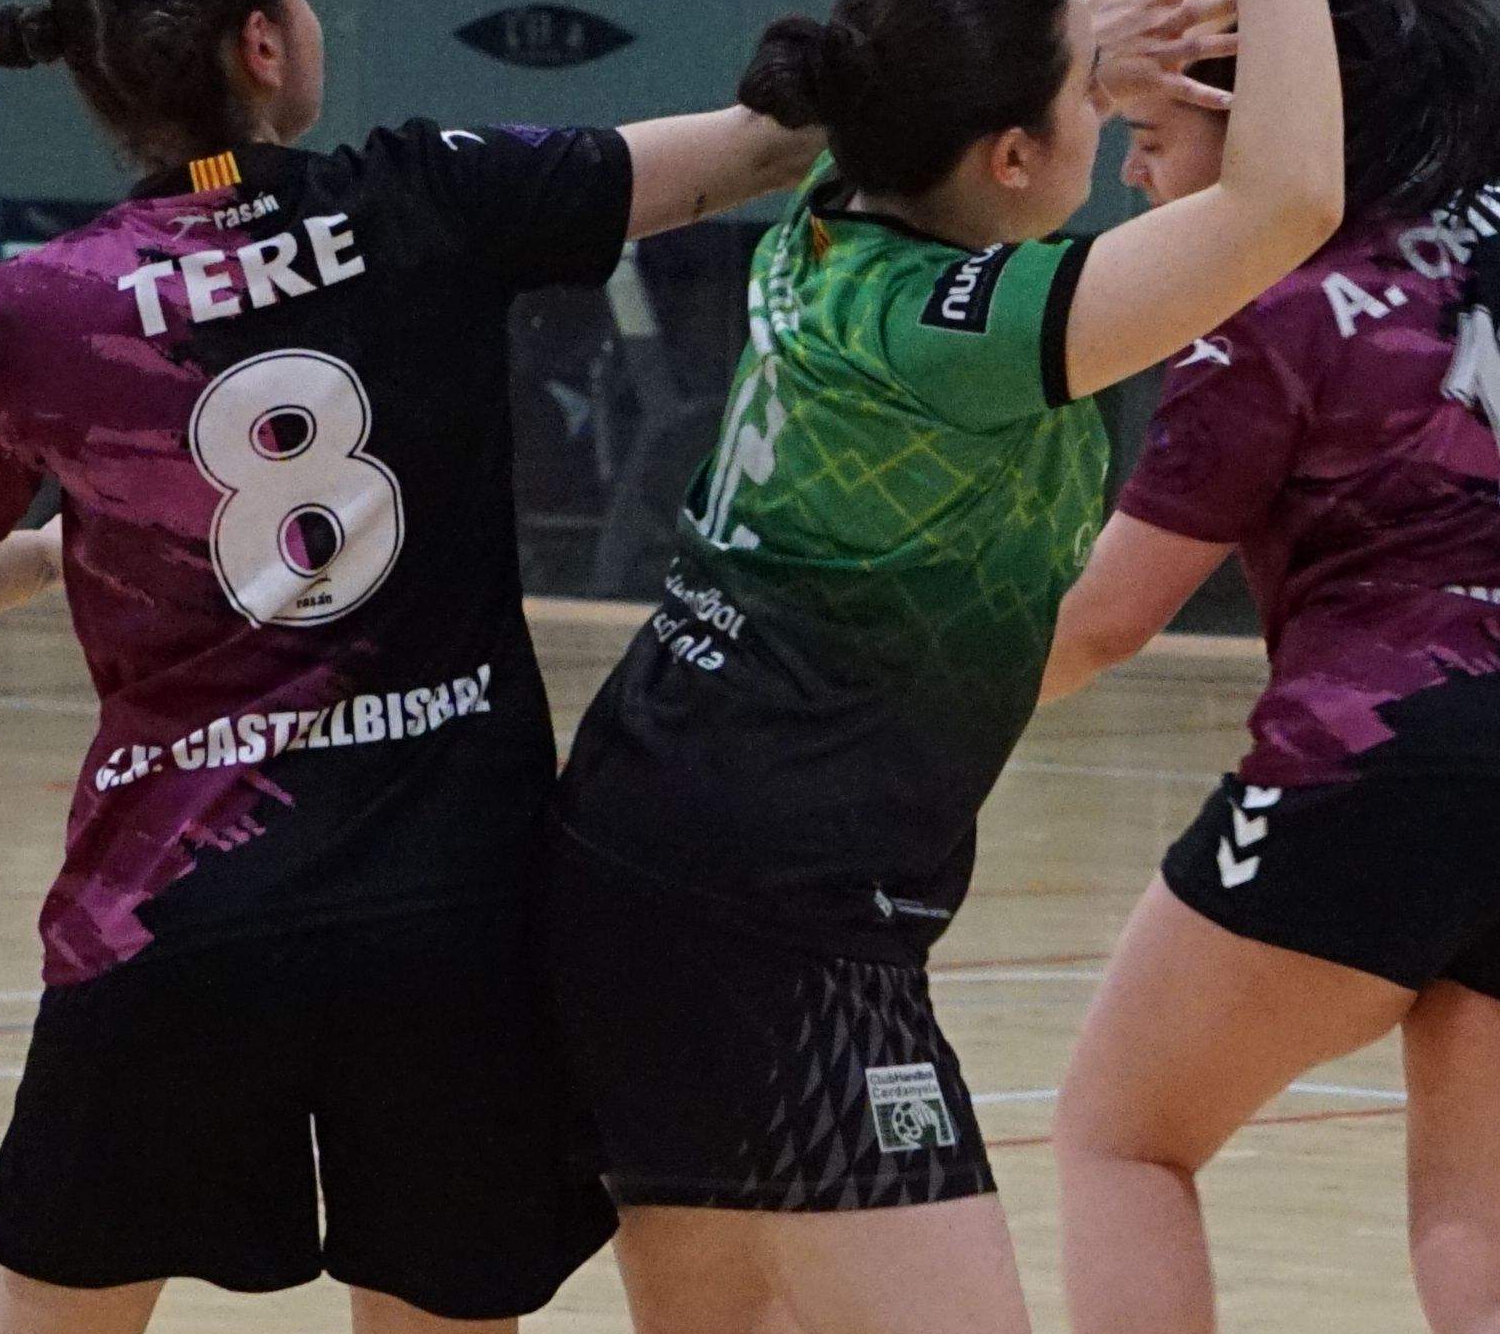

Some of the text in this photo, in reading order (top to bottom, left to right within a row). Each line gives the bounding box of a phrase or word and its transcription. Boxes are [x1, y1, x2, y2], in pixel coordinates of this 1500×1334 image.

[117, 213, 366, 338] TERE
[1320, 271, 1408, 339] A.
[188, 347, 405, 629] 8
